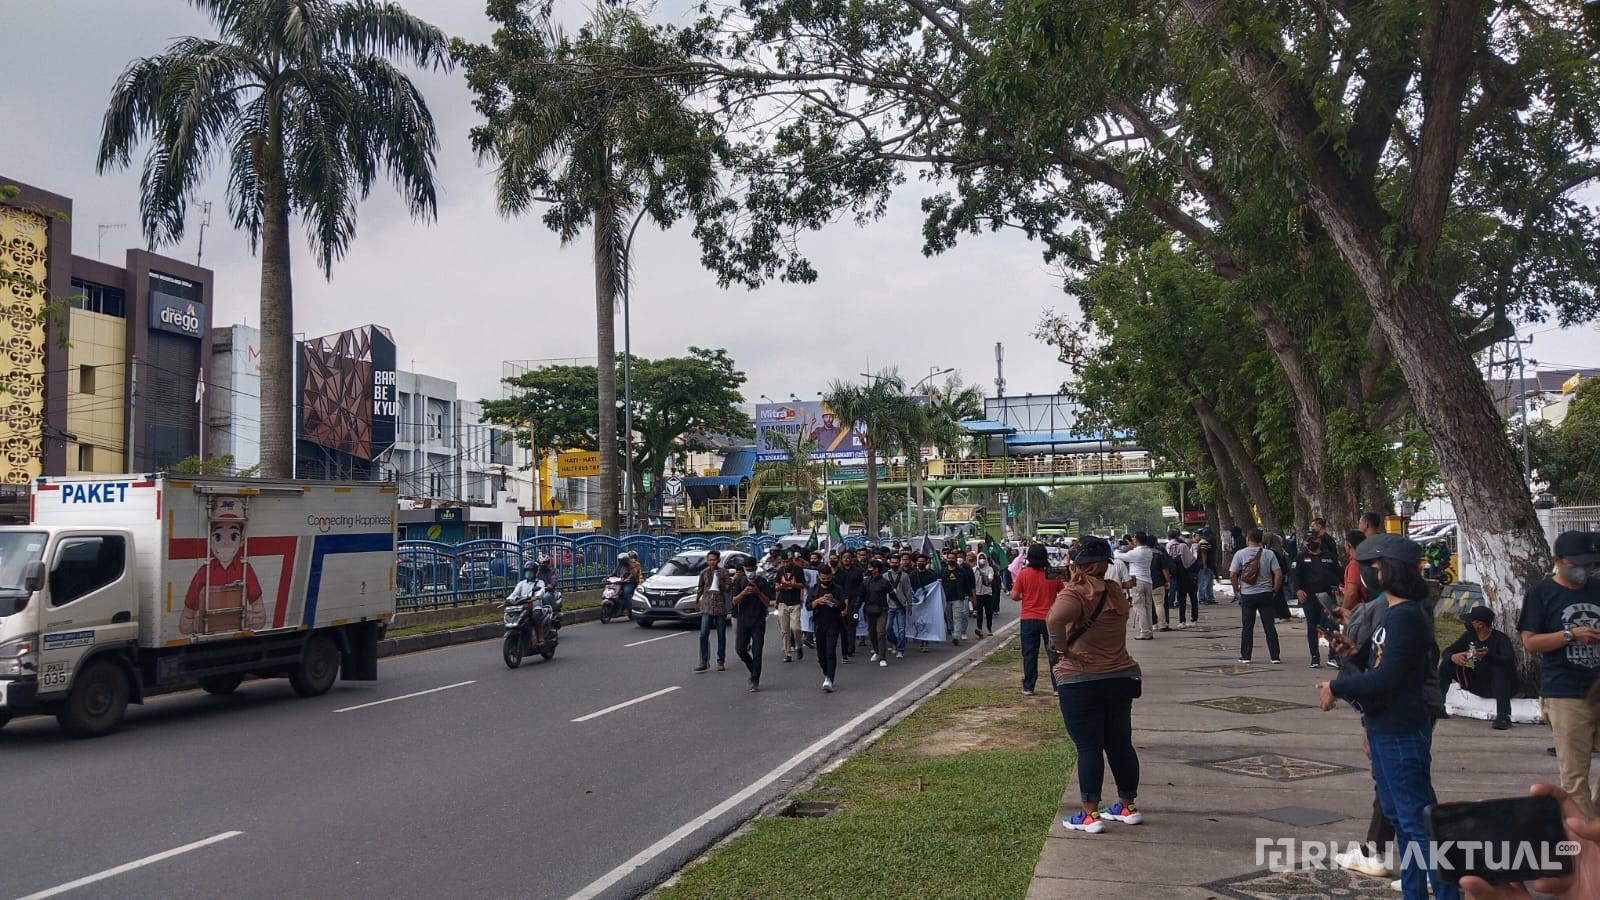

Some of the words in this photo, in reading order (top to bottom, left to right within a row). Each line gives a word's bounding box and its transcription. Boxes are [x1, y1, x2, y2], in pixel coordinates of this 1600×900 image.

[160, 307, 199, 331] drego
[374, 371, 396, 385] BAR
[374, 386, 388, 400] BE
[374, 401, 396, 416] KYU
[62, 482, 129, 504] PAKET
[307, 514, 354, 530] Connecting
[355, 513, 391, 527] Happiness
[44, 672, 66, 685] 035
